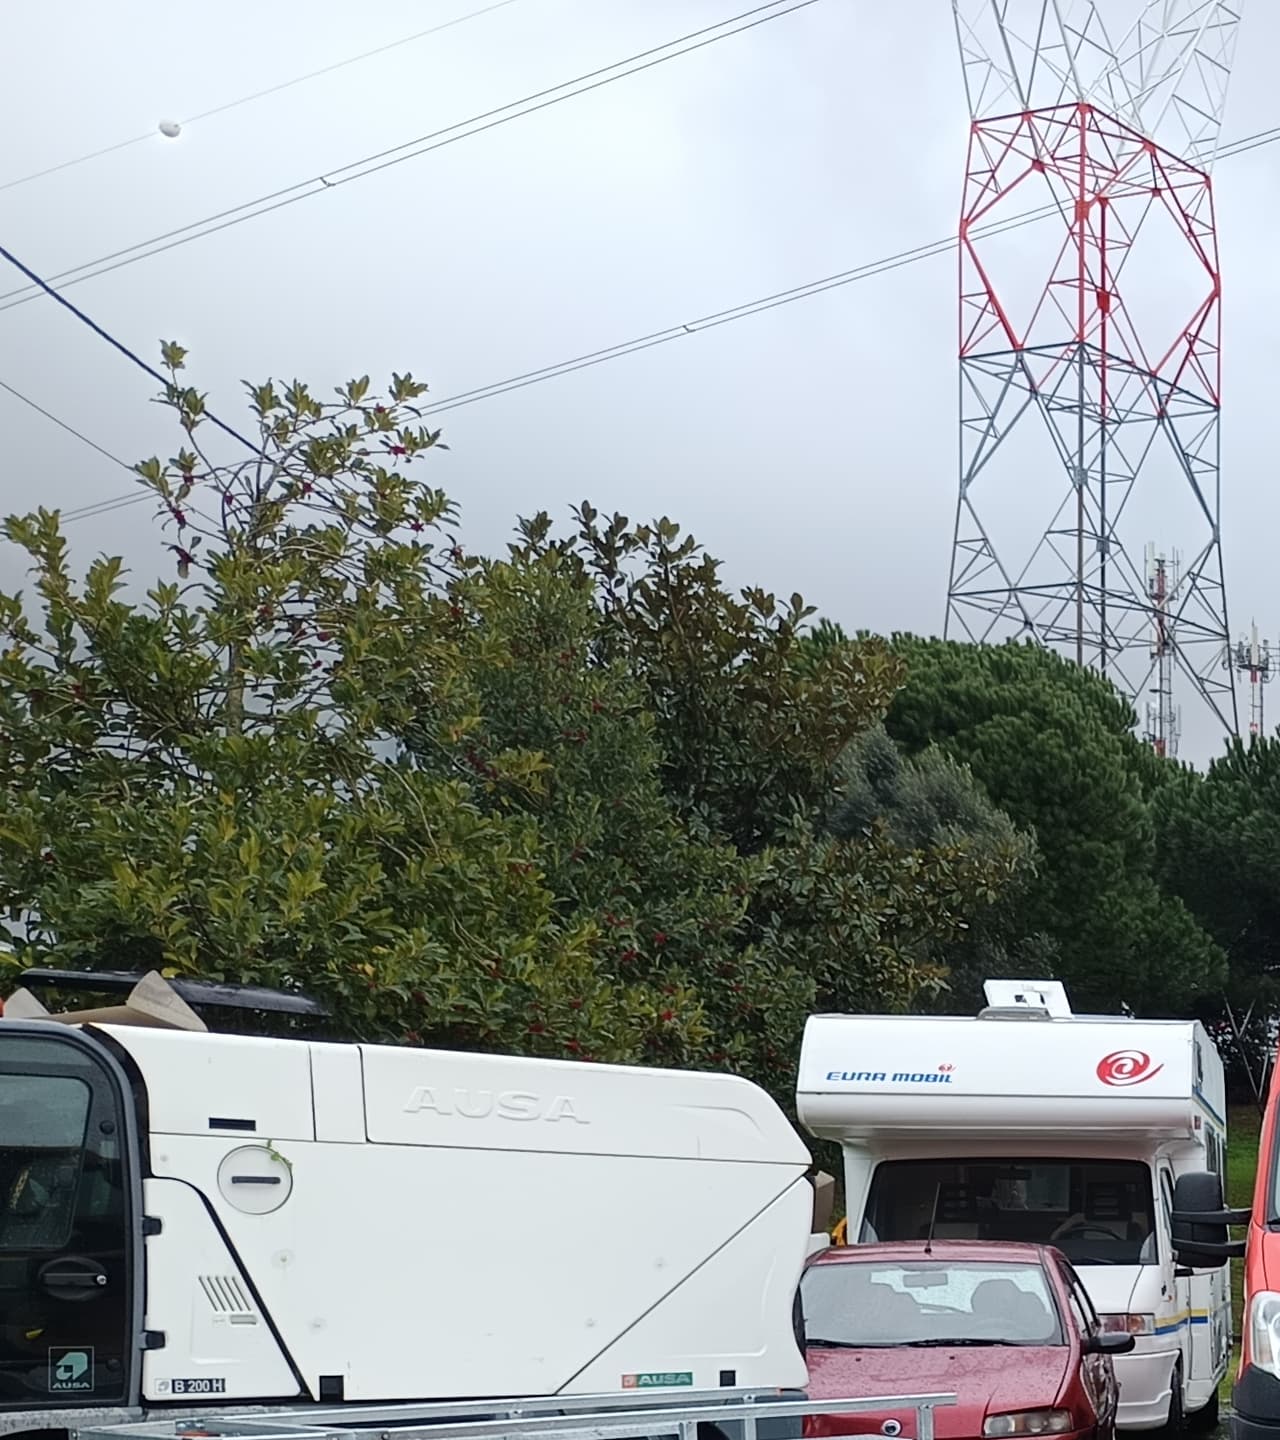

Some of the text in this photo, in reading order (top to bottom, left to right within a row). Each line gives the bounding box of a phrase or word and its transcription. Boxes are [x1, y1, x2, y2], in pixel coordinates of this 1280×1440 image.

[826, 1071, 953, 1084] EURA MOBIL
[403, 1085, 592, 1125] AUSA
[174, 1379, 223, 1392] B 200 H
[638, 1374, 691, 1385] AUSA
